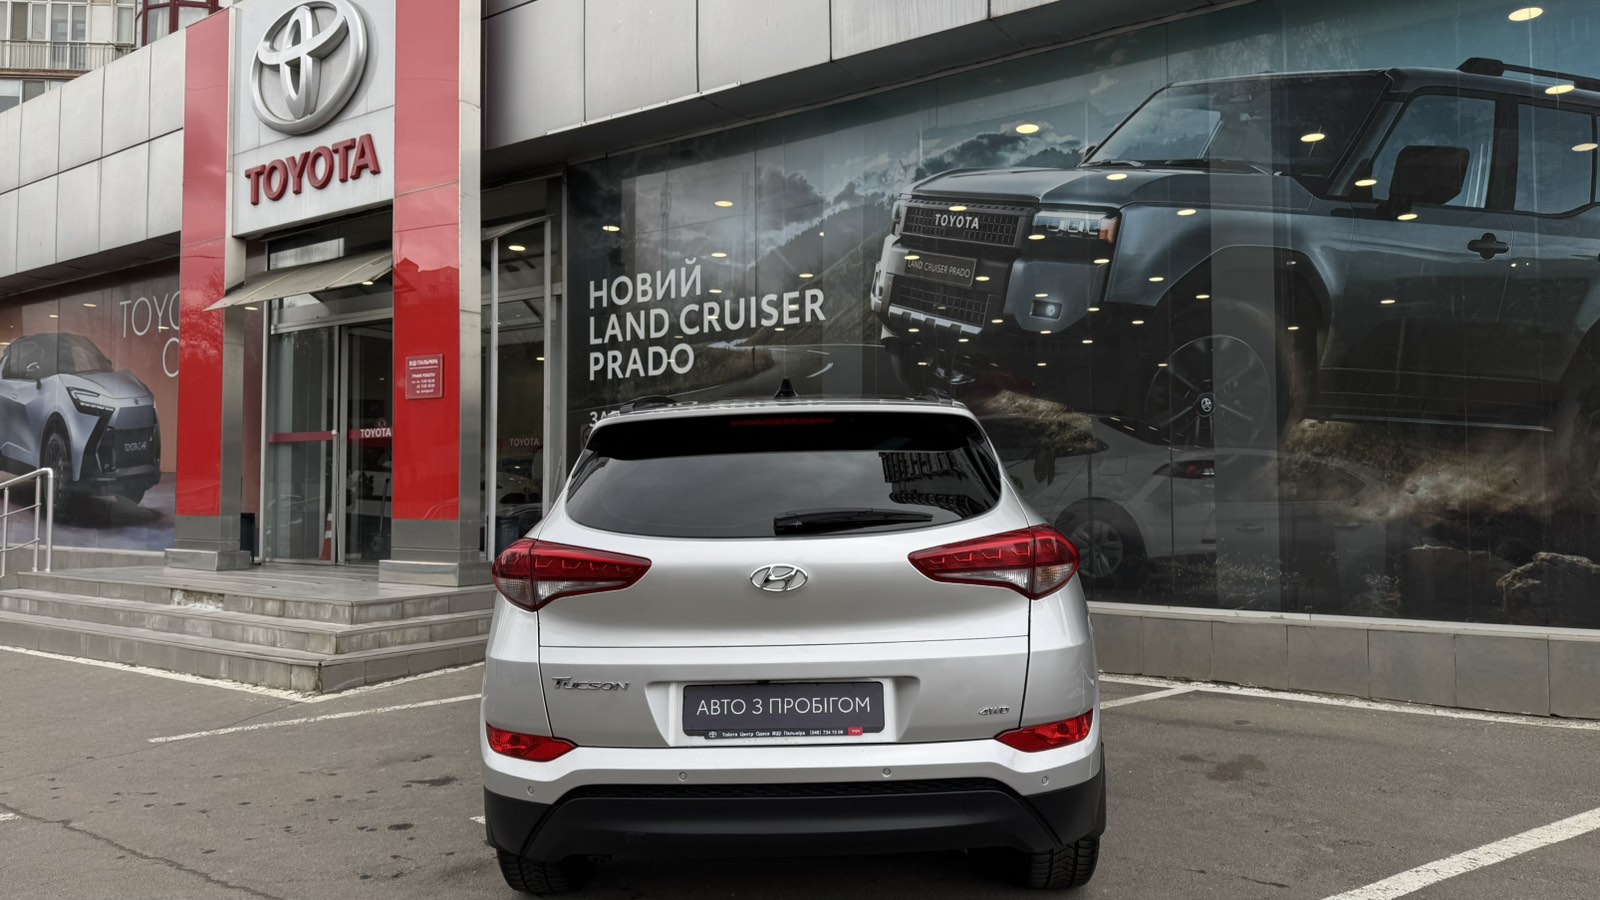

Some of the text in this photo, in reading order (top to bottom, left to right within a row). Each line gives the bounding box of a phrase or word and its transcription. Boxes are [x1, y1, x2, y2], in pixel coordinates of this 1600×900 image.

[245, 133, 381, 206] TOYOTA
[935, 214, 979, 229] TOYOTA
[908, 260, 971, 278] LAND CRUISER PRADO
[589, 257, 701, 309] НОВИЙ
[589, 288, 826, 345] LAND CRUISER
[589, 343, 695, 381] PRADO
[360, 427, 392, 439] TOYOTA
[509, 438, 540, 447] TOYOTA
[696, 699, 747, 716] АВТО
[769, 697, 871, 714] ПРОБІГОМ
[978, 706, 1010, 715] 4WD
